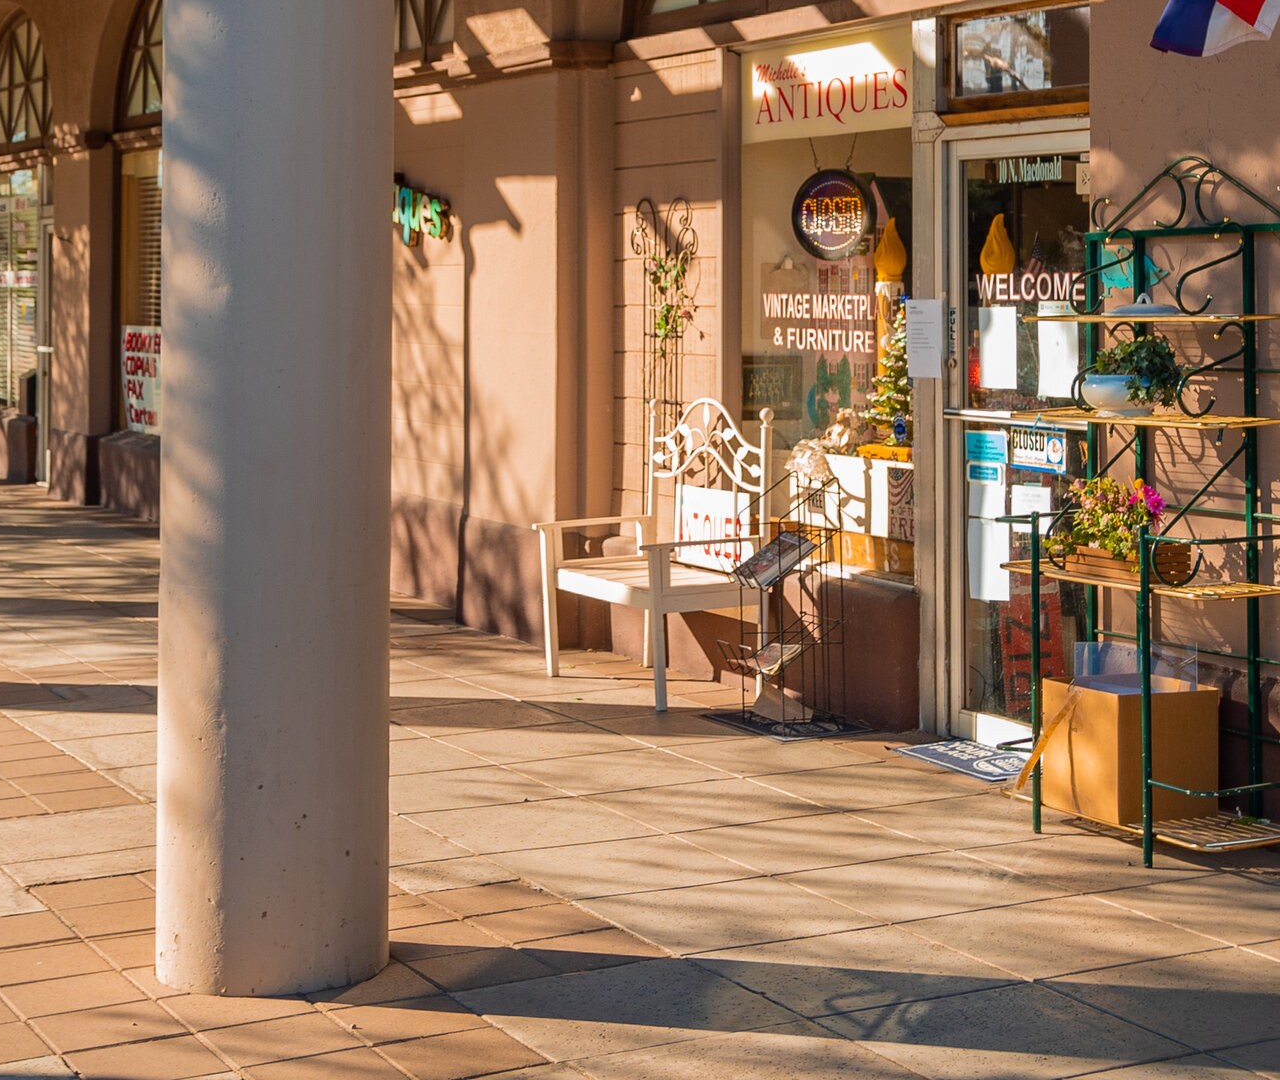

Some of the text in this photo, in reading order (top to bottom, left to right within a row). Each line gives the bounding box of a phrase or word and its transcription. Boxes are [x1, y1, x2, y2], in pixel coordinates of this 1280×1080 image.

[755, 68, 908, 125] ANTIQUES
[999, 155, 1062, 184] 10 N. Macdonald
[976, 272, 1086, 301] WELCOME
[763, 293, 898, 321] VINTAGE MARKETPLE
[773, 326, 875, 354] & FURNITURE
[127, 379, 144, 401] FAX
[1012, 429, 1045, 452] CLOSED
